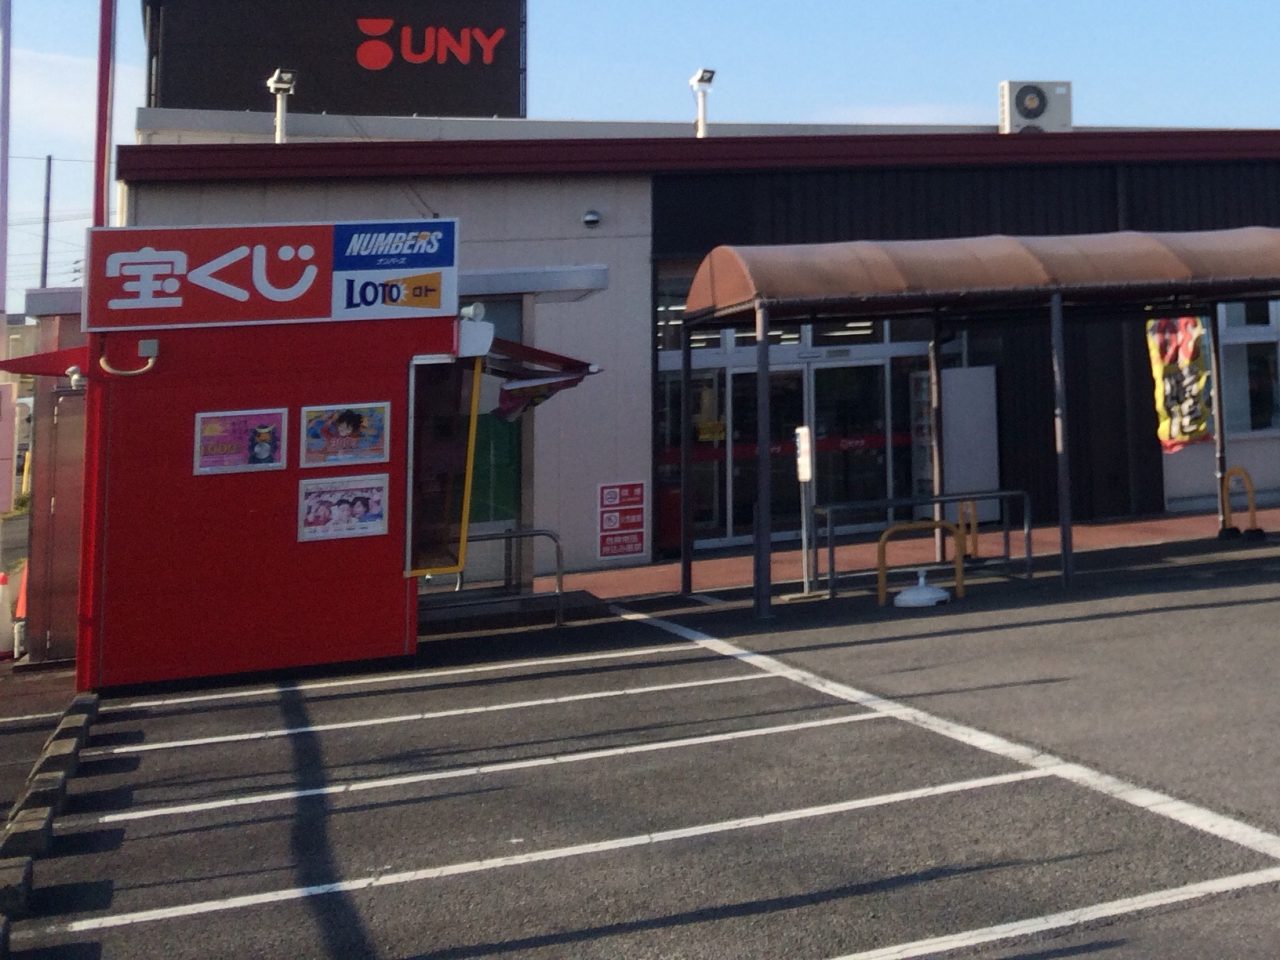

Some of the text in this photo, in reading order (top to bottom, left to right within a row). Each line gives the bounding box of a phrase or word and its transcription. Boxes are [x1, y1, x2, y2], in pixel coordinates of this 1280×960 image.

[401, 25, 506, 65] UNY
[345, 231, 443, 256] NUMBERS
[105, 244, 318, 310] 宝くじ
[412, 285, 437, 298] ロト
[345, 278, 401, 310] LOTO
